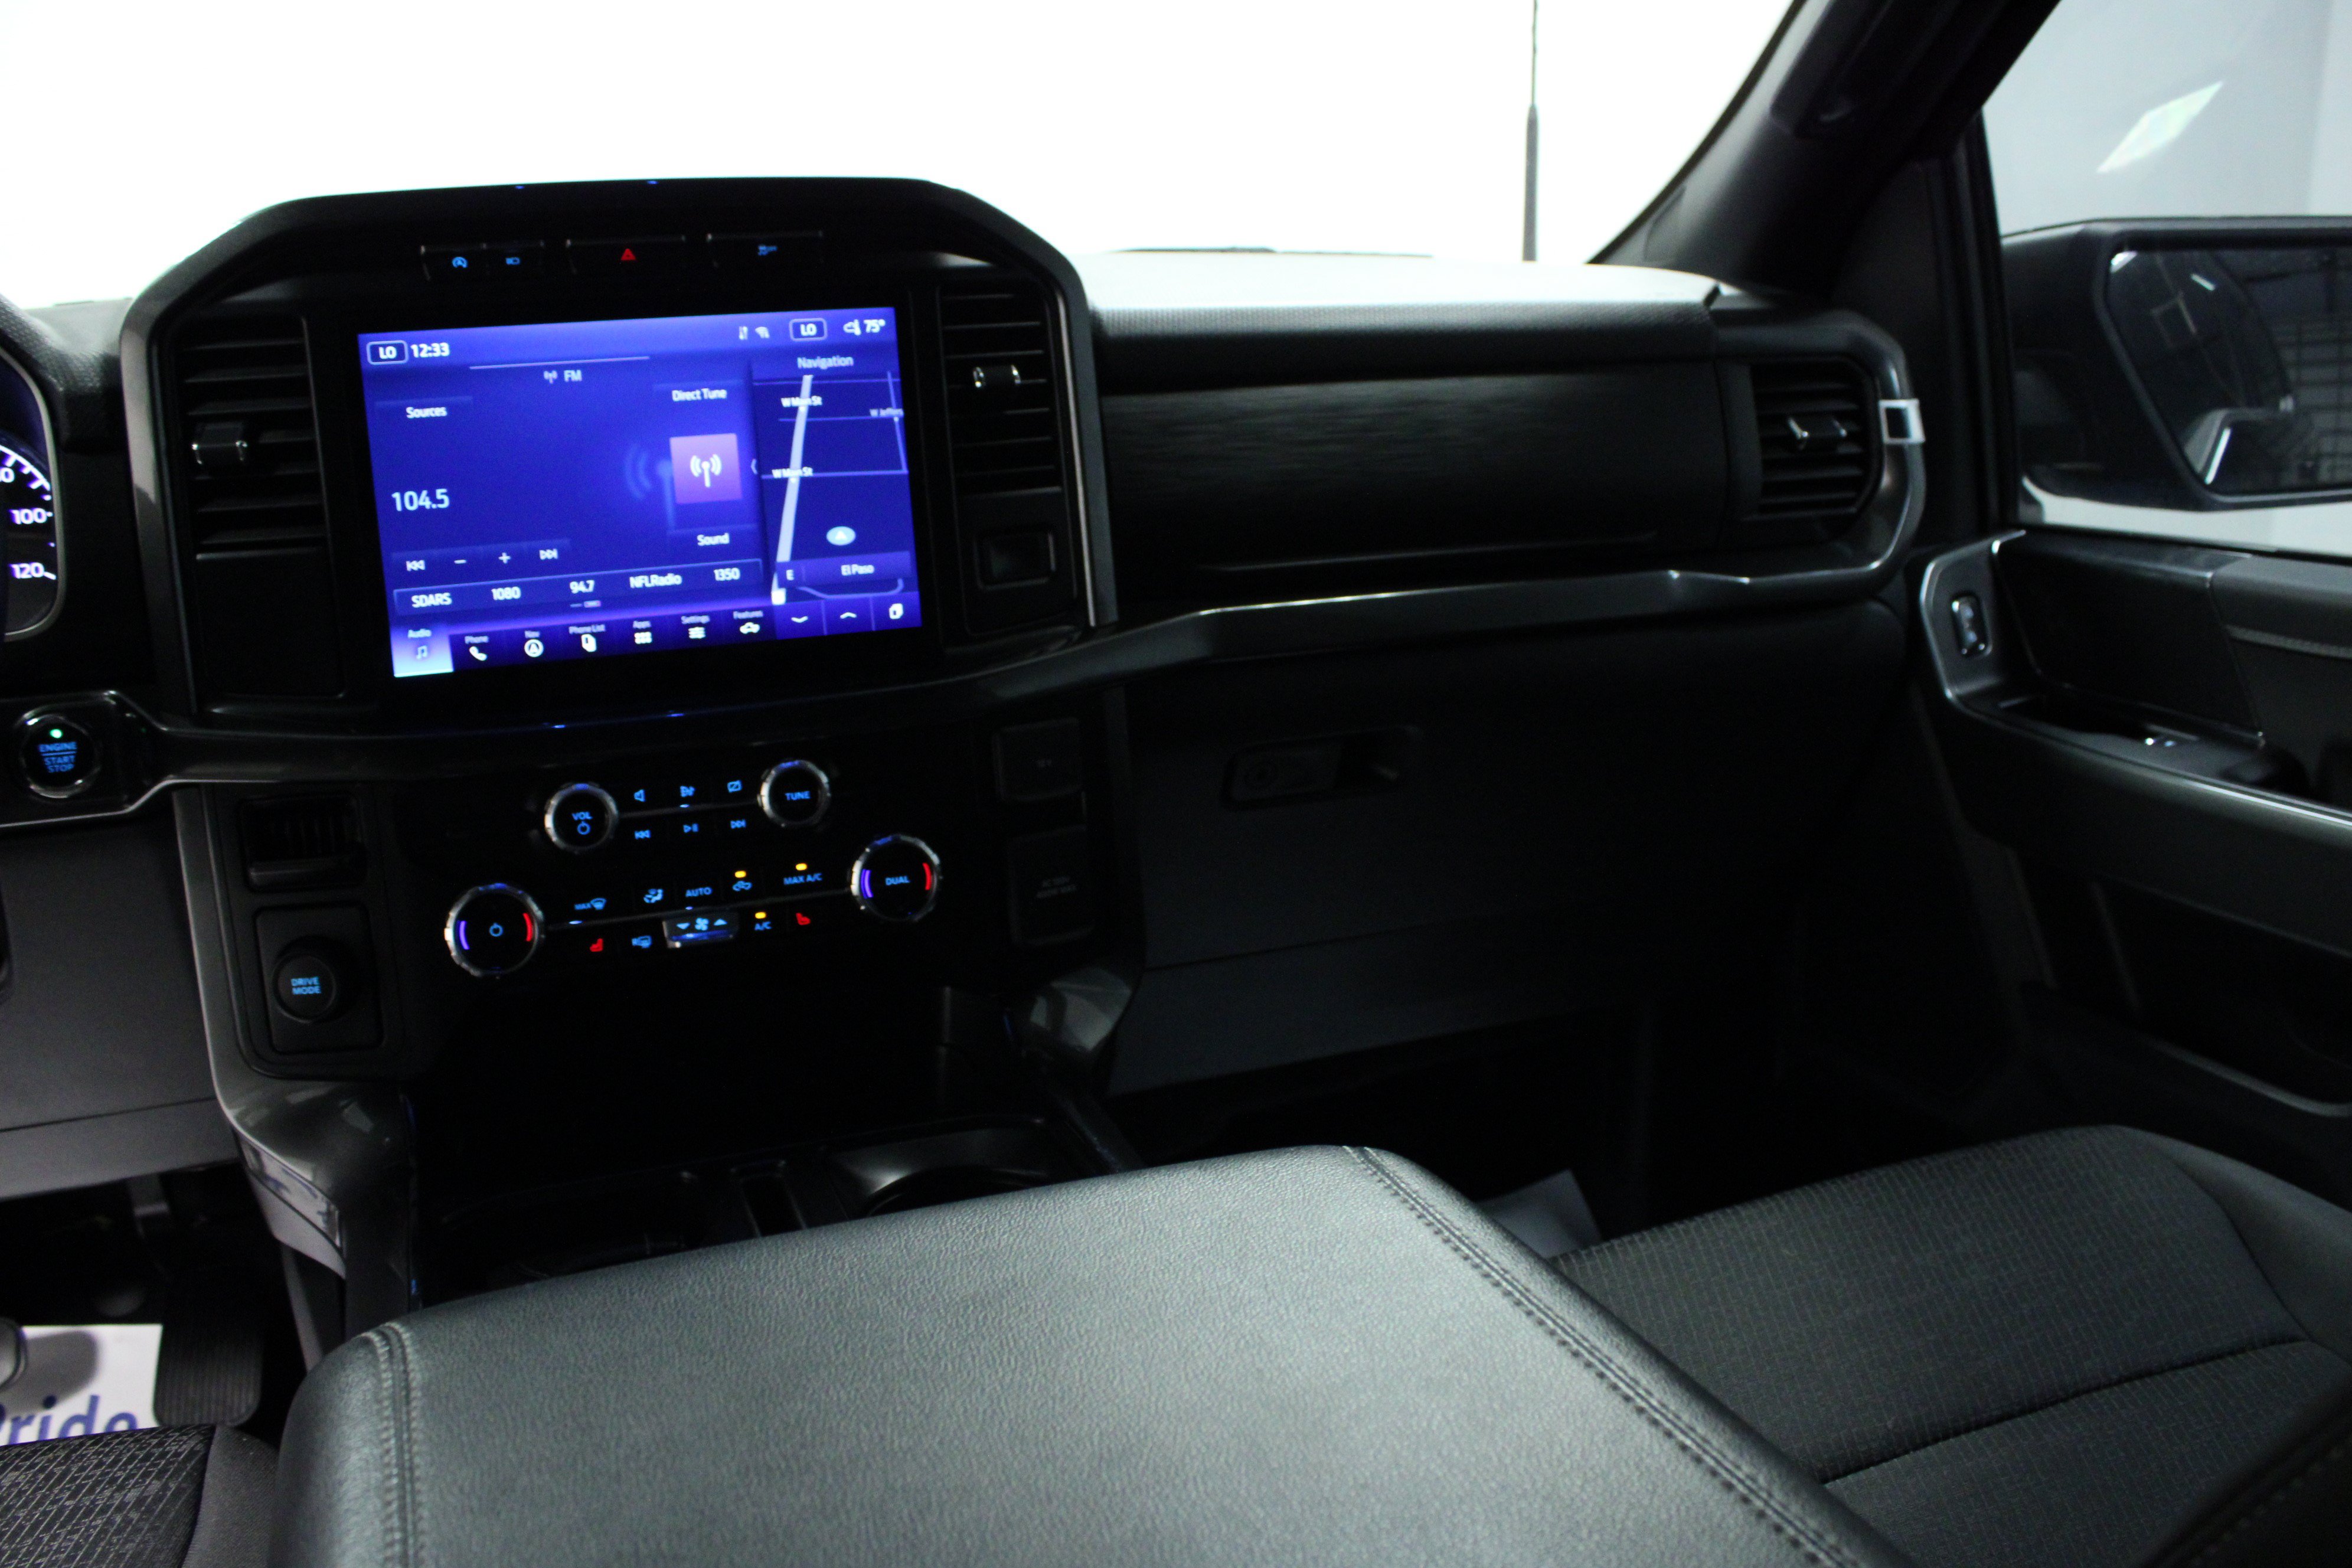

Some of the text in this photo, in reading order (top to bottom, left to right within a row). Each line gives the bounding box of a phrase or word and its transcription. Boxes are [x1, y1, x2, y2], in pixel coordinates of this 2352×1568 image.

[800, 323, 816, 337] LO
[864, 319, 886, 332] 75°
[378, 346, 397, 359] LO
[411, 342, 450, 358] 12:33
[798, 355, 854, 369] Navigation
[564, 370, 582, 382] FM
[672, 388, 727, 401] Direct Tune
[406, 407, 447, 419] Sources
[0, 467, 15, 484] 0
[391, 488, 450, 511] 104.5
[11, 508, 47, 524] 100
[697, 533, 730, 546] Sound
[11, 562, 44, 579] 120
[714, 567, 740, 581] 1350
[841, 564, 874, 576] El Paso
[491, 586, 521, 600] 1080
[570, 580, 594, 594] 94.7
[411, 593, 452, 608] SDARS
[681, 615, 710, 625] Settings
[733, 610, 763, 620] Features
[407, 628, 432, 638] Audio
[39, 741, 77, 752] ENGINE
[44, 756, 76, 765] START
[47, 765, 75, 773] STOP
[785, 791, 811, 801] TUNE
[572, 812, 593, 821] VOL
[783, 873, 822, 885] MAX A/C
[886, 876, 910, 886] DUAL
[685, 887, 712, 897] AUTO
[754, 922, 771, 931] A/C
[291, 976, 319, 986] DRIVE
[292, 985, 321, 995] MODE
